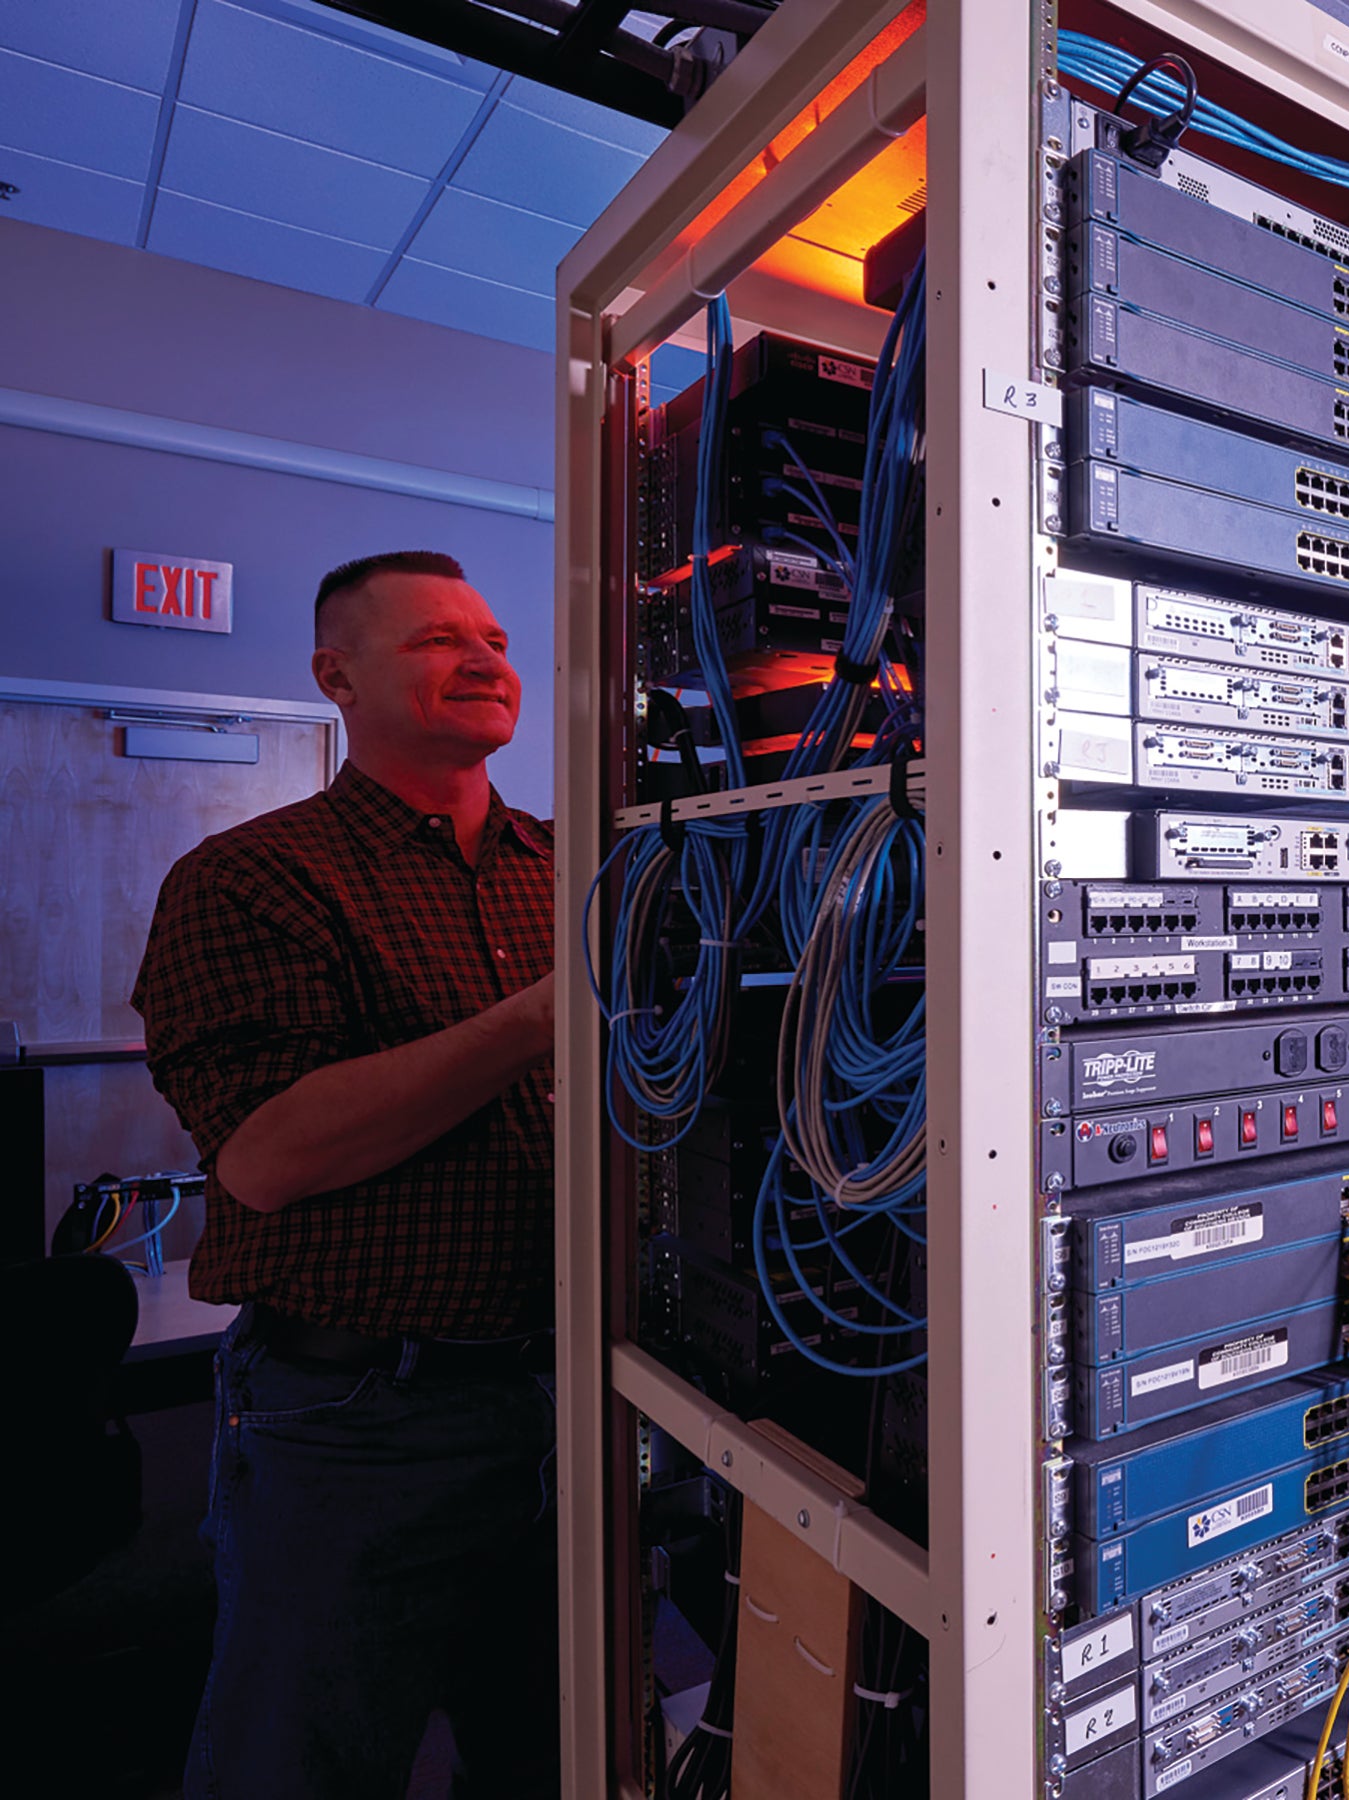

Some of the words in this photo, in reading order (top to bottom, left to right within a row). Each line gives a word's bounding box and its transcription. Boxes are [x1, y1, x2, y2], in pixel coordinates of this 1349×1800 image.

[1025, 392, 1037, 407] 3
[134, 561, 219, 620] EXIT
[1186, 938, 1226, 947] Workstation
[1210, 1504, 1232, 1523] CSN
[1052, 1562, 1070, 1578] S10
